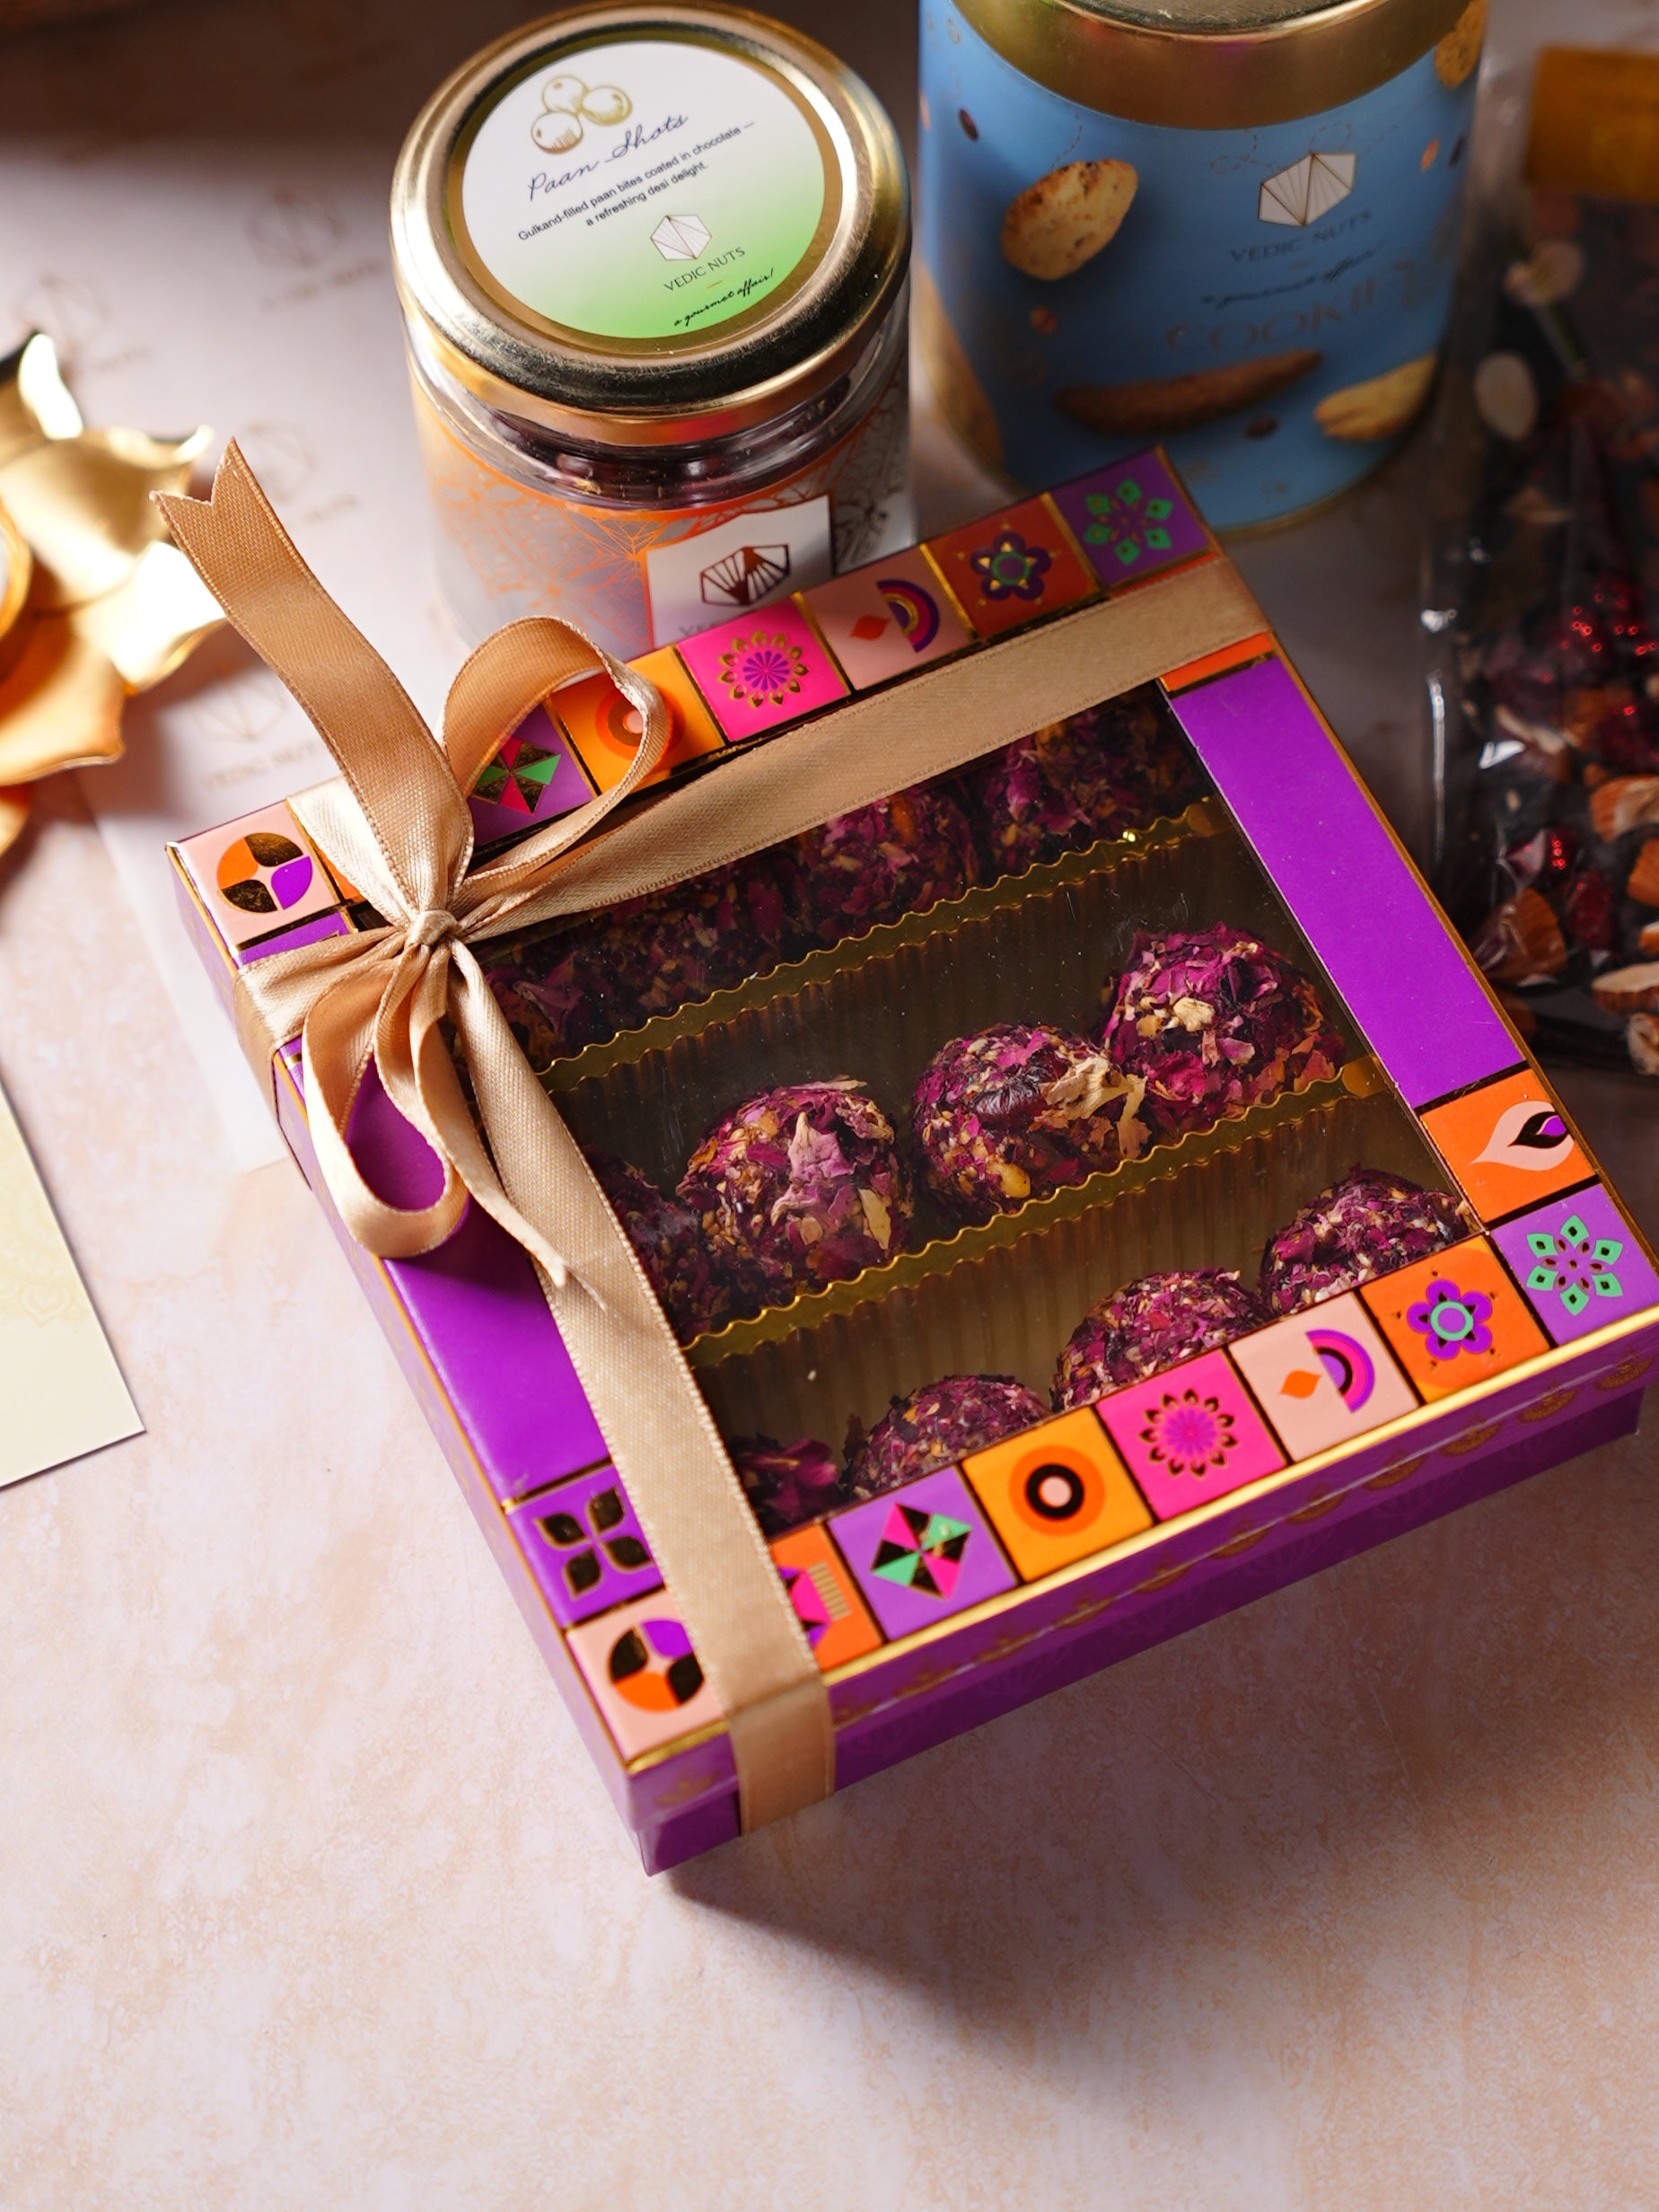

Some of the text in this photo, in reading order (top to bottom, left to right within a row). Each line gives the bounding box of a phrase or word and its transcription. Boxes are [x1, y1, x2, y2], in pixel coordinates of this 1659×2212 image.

[518, 200, 589, 241] Gulkand-filled
[590, 189, 617, 208] paan
[617, 175, 643, 192] bites
[644, 156, 679, 180] coated
[681, 152, 691, 161] in
[692, 127, 741, 155] chocolate
[528, 114, 689, 201] Paan Shots
[586, 161, 709, 227] a refreshing desi delight.
[664, 246, 746, 292] VEDIC NUTS
[684, 290, 734, 327] gourmet
